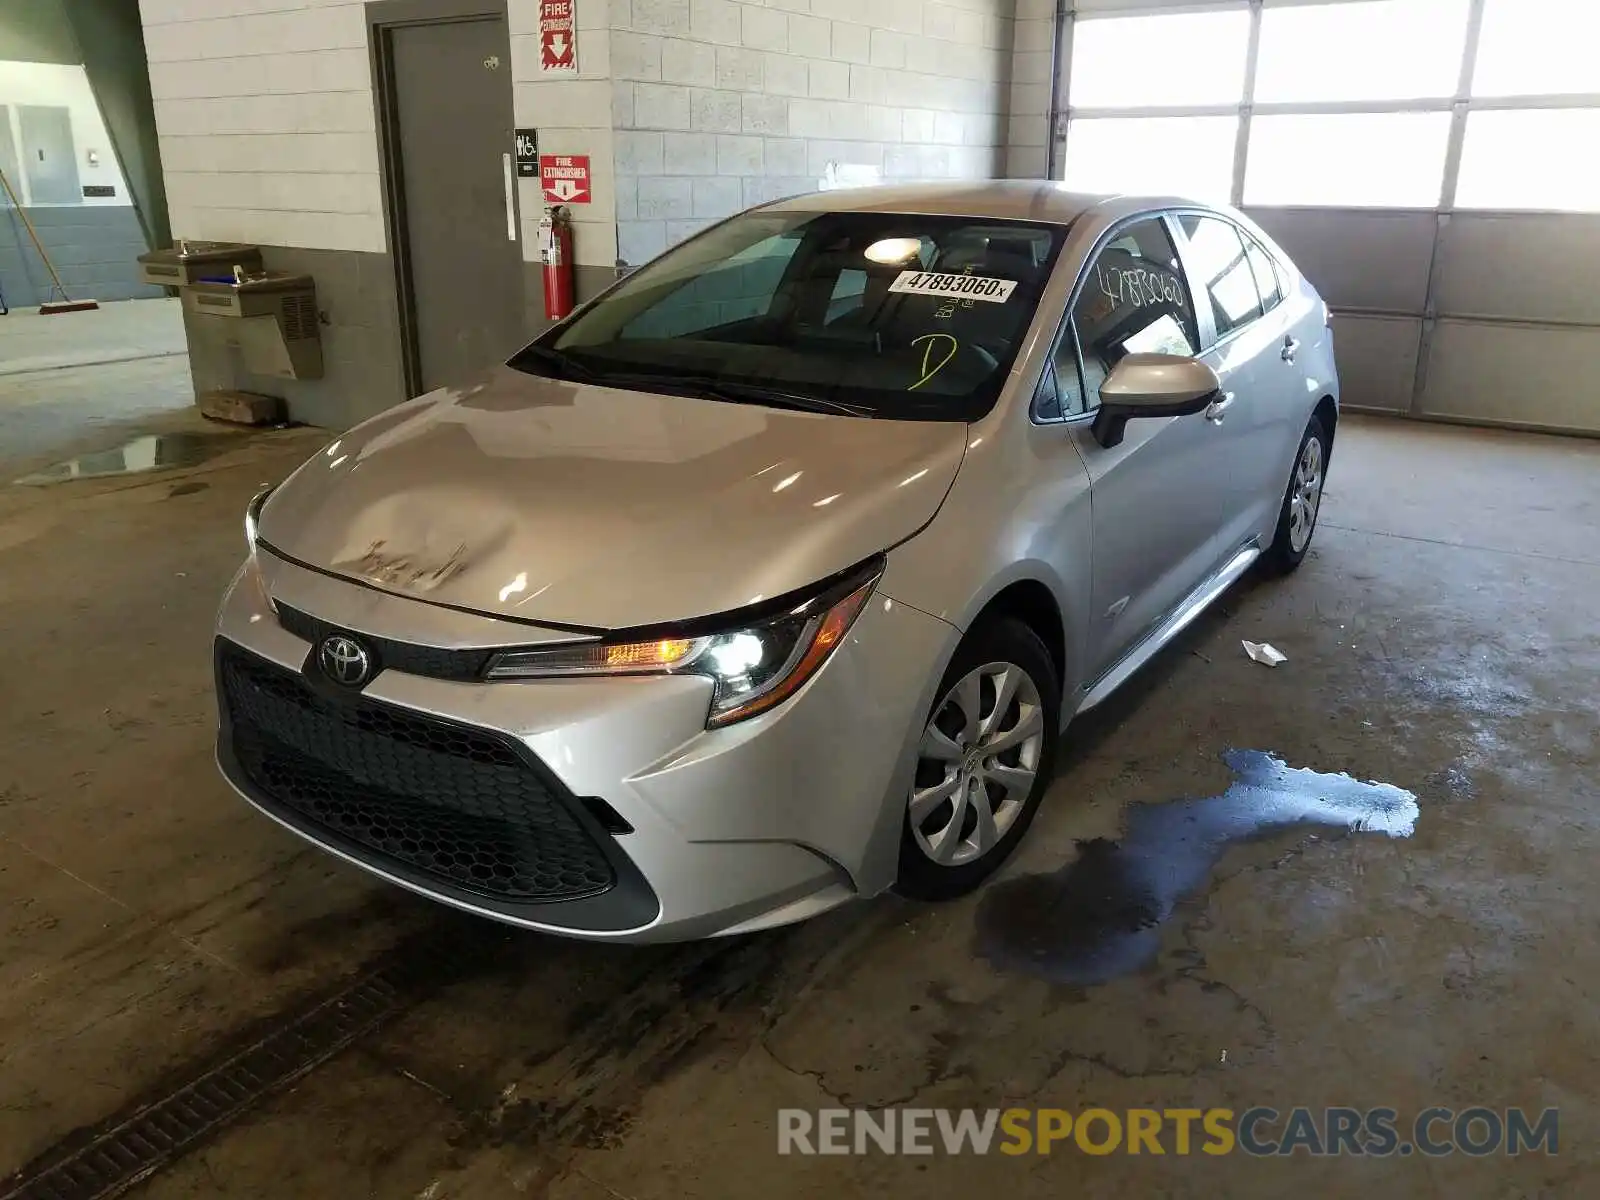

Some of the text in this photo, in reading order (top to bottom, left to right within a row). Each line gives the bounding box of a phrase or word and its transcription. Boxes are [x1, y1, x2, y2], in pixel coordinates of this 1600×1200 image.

[544, 2, 569, 16] FIRE
[555, 157, 573, 166] FIRE
[544, 167, 586, 178] EXTINGUISHER
[908, 333, 958, 391] D
